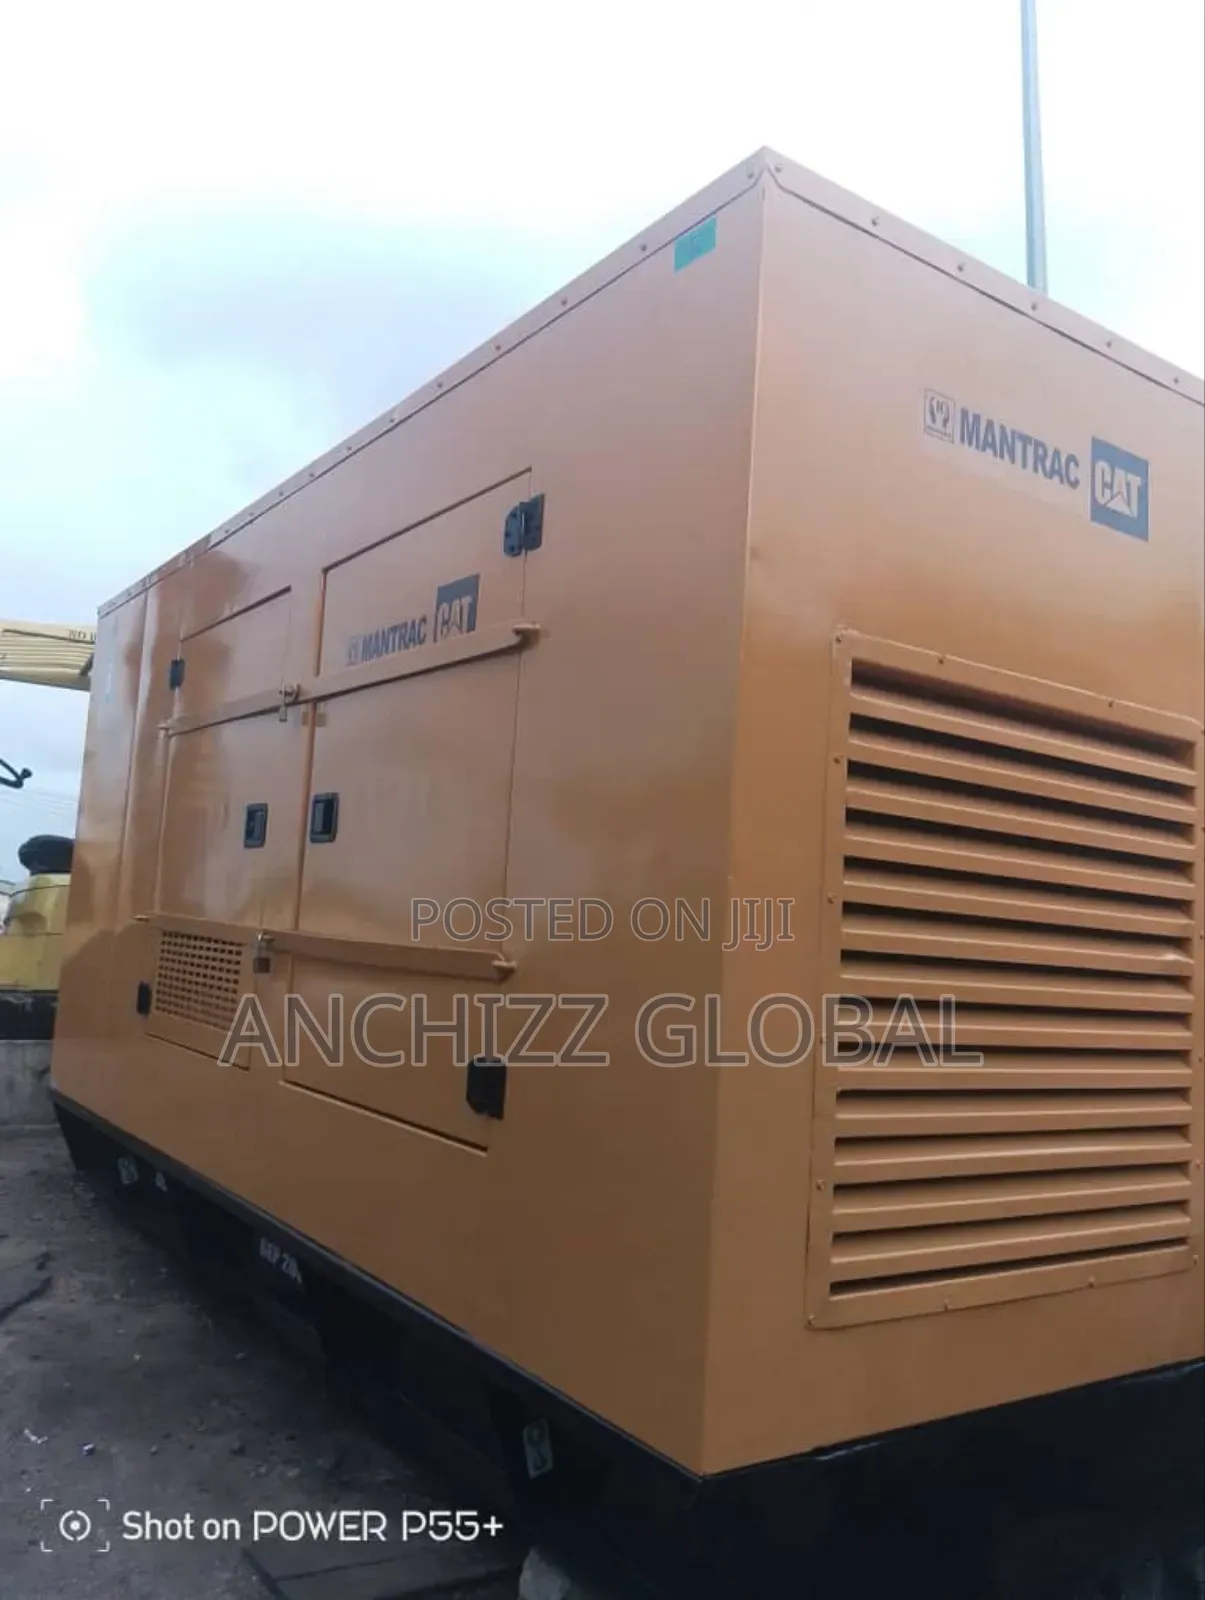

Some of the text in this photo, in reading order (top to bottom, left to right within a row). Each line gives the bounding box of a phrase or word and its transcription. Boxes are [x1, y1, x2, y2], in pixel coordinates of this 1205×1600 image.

[960, 407, 1143, 519] MANTRAC CAT
[361, 596, 472, 662] MANTRAC CAT
